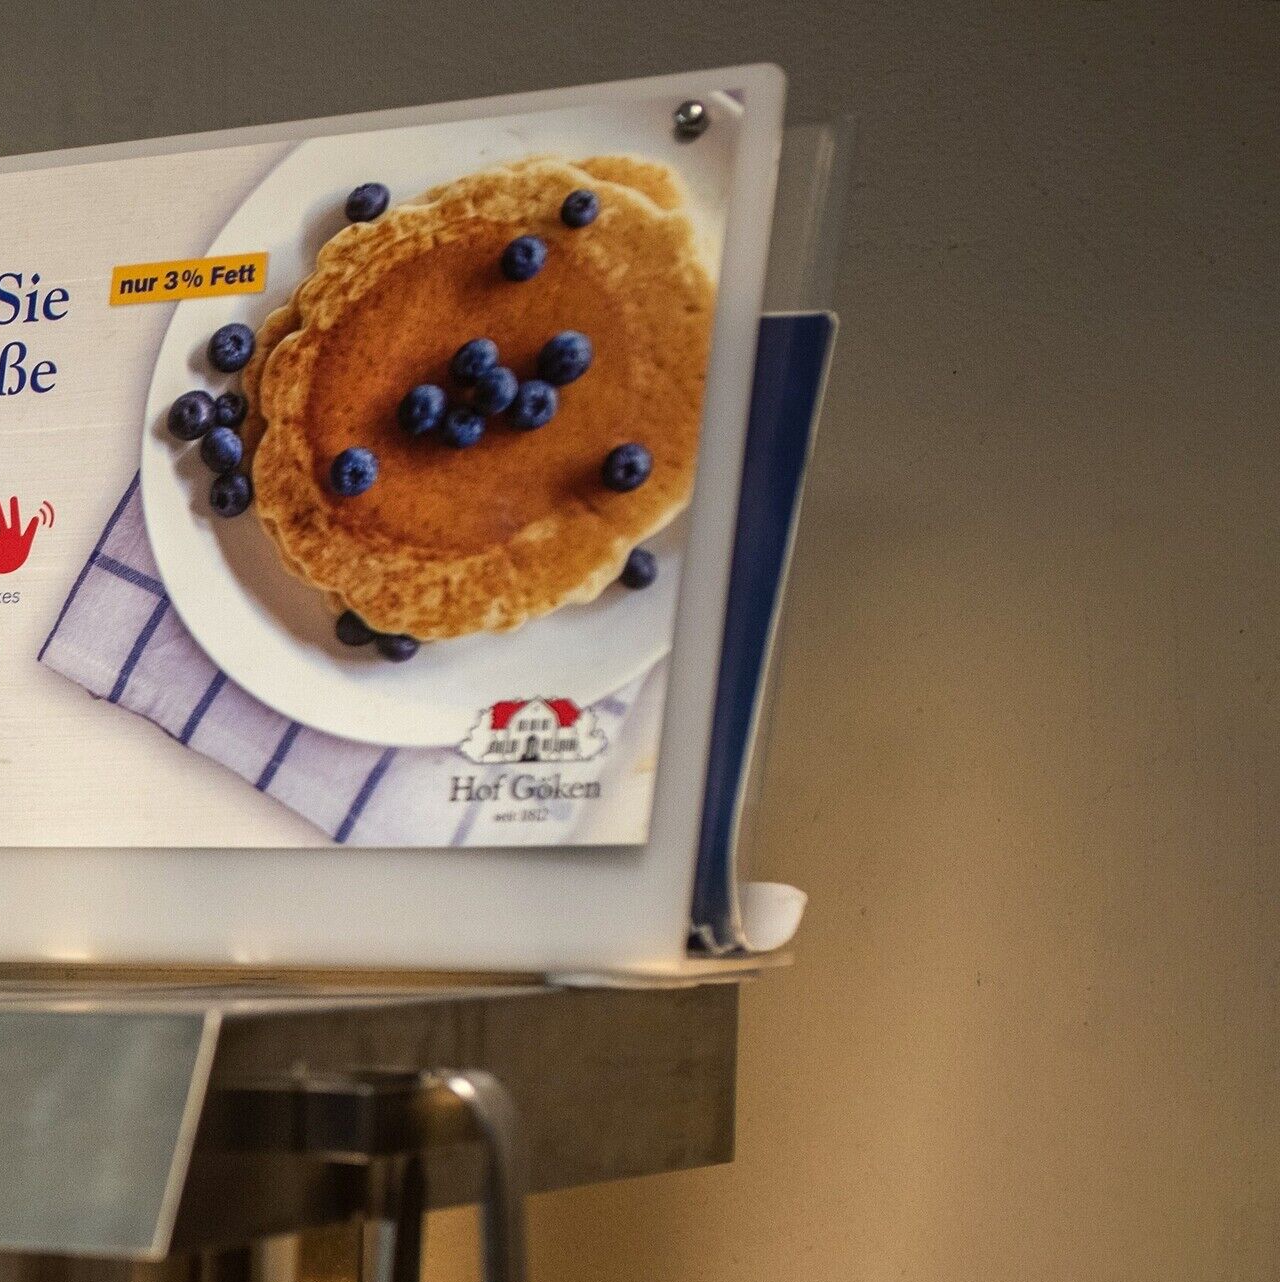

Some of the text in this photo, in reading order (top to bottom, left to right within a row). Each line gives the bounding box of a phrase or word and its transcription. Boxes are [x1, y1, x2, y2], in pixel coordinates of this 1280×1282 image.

[120, 276, 158, 294] nur
[210, 264, 256, 285] Fett
[449, 773, 601, 801] Hof Göken
